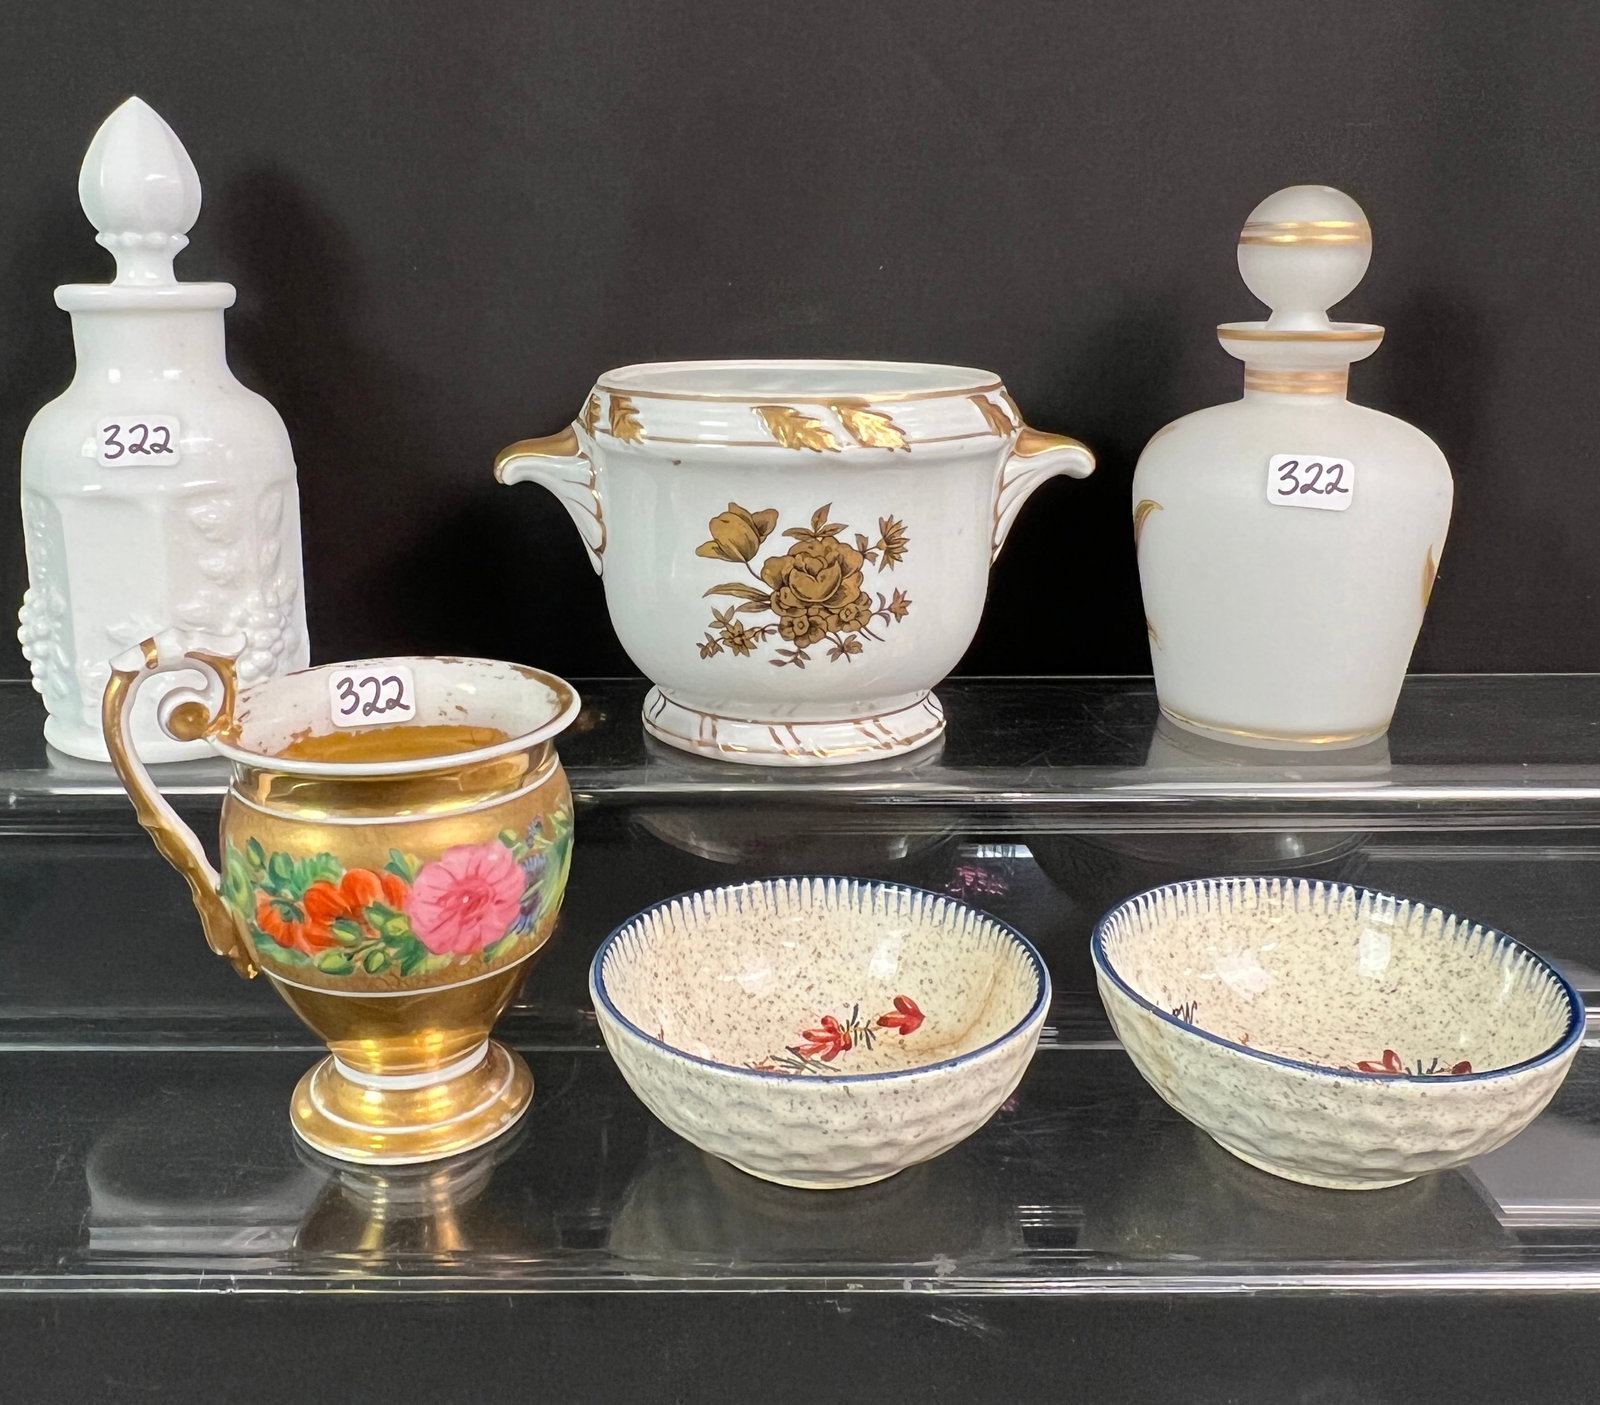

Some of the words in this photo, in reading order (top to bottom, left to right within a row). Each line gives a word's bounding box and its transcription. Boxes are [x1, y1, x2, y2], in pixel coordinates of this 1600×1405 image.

[103, 423, 174, 460] 322
[1277, 460, 1349, 496] 322
[336, 675, 411, 717] 322
